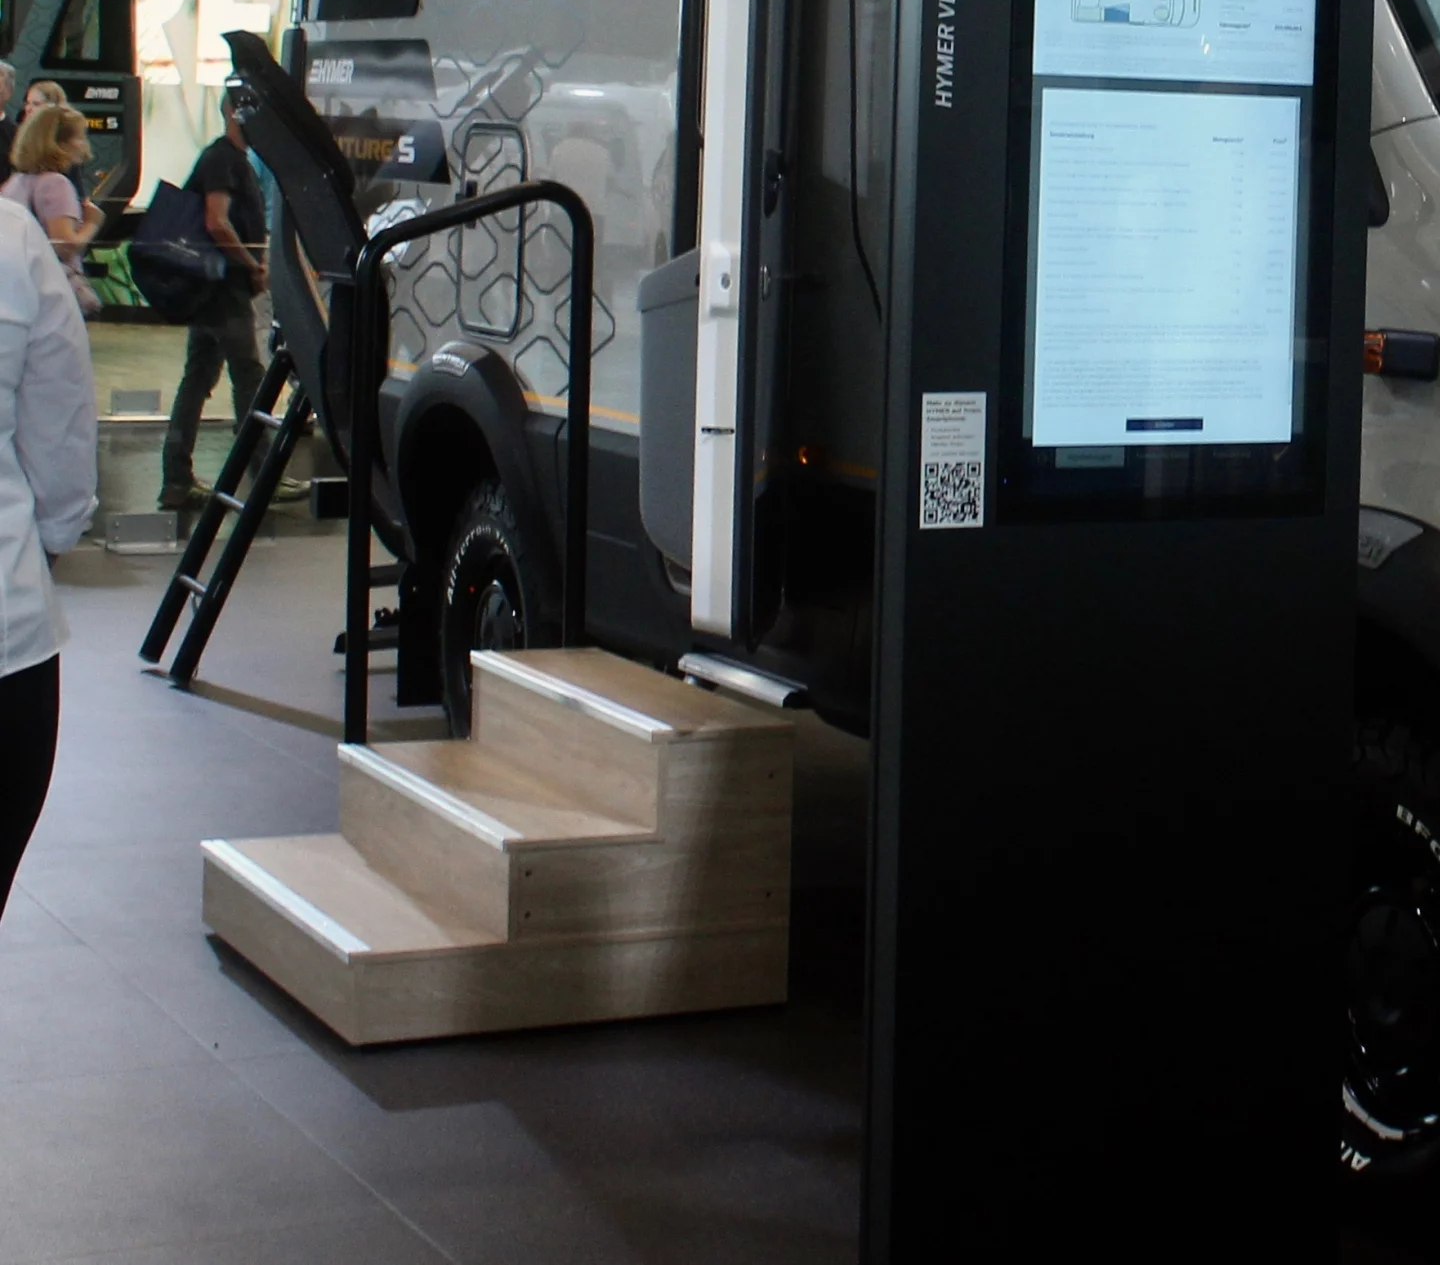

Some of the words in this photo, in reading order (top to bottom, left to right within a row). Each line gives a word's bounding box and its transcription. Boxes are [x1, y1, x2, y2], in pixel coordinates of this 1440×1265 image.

[319, 58, 354, 85] HYMER
[935, 22, 955, 109] HYMER
[397, 135, 416, 164] S
